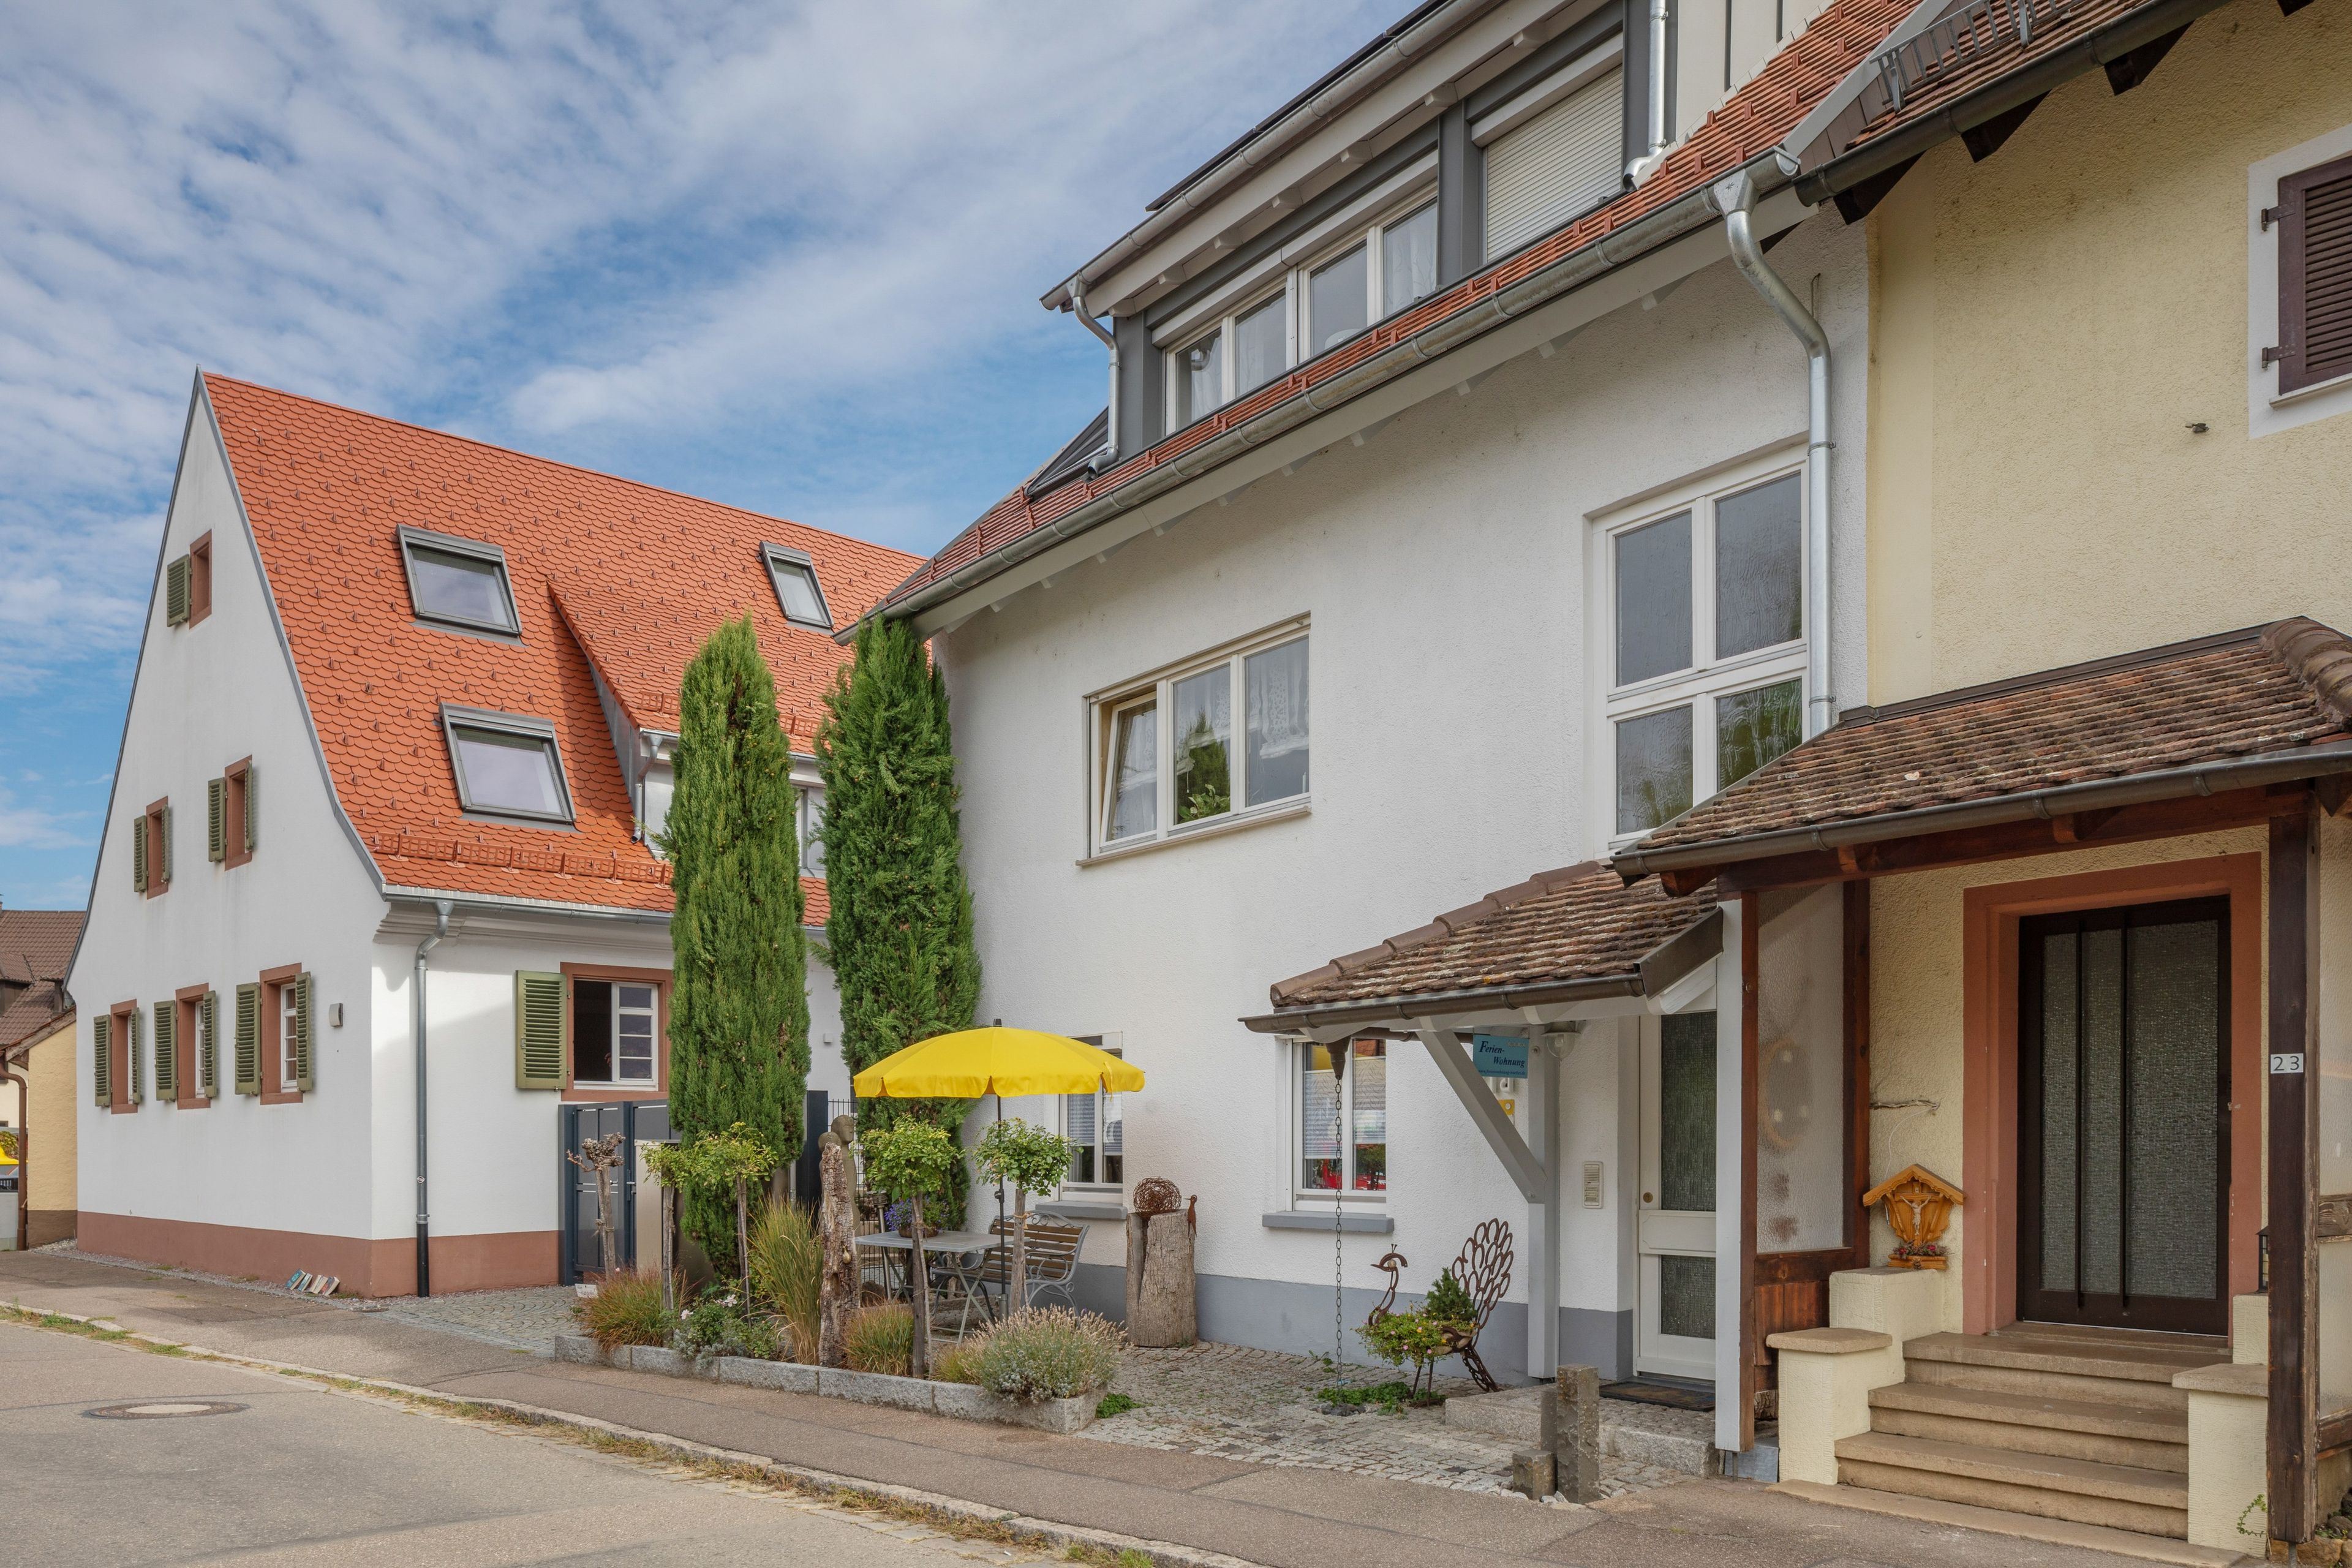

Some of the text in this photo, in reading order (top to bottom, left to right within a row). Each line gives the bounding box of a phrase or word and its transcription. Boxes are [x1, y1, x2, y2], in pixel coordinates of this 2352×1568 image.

[1479, 1041, 1505, 1054] Ferien-
[1493, 1056, 1525, 1068] Wohnung
[2273, 1055, 2299, 1071] 23
